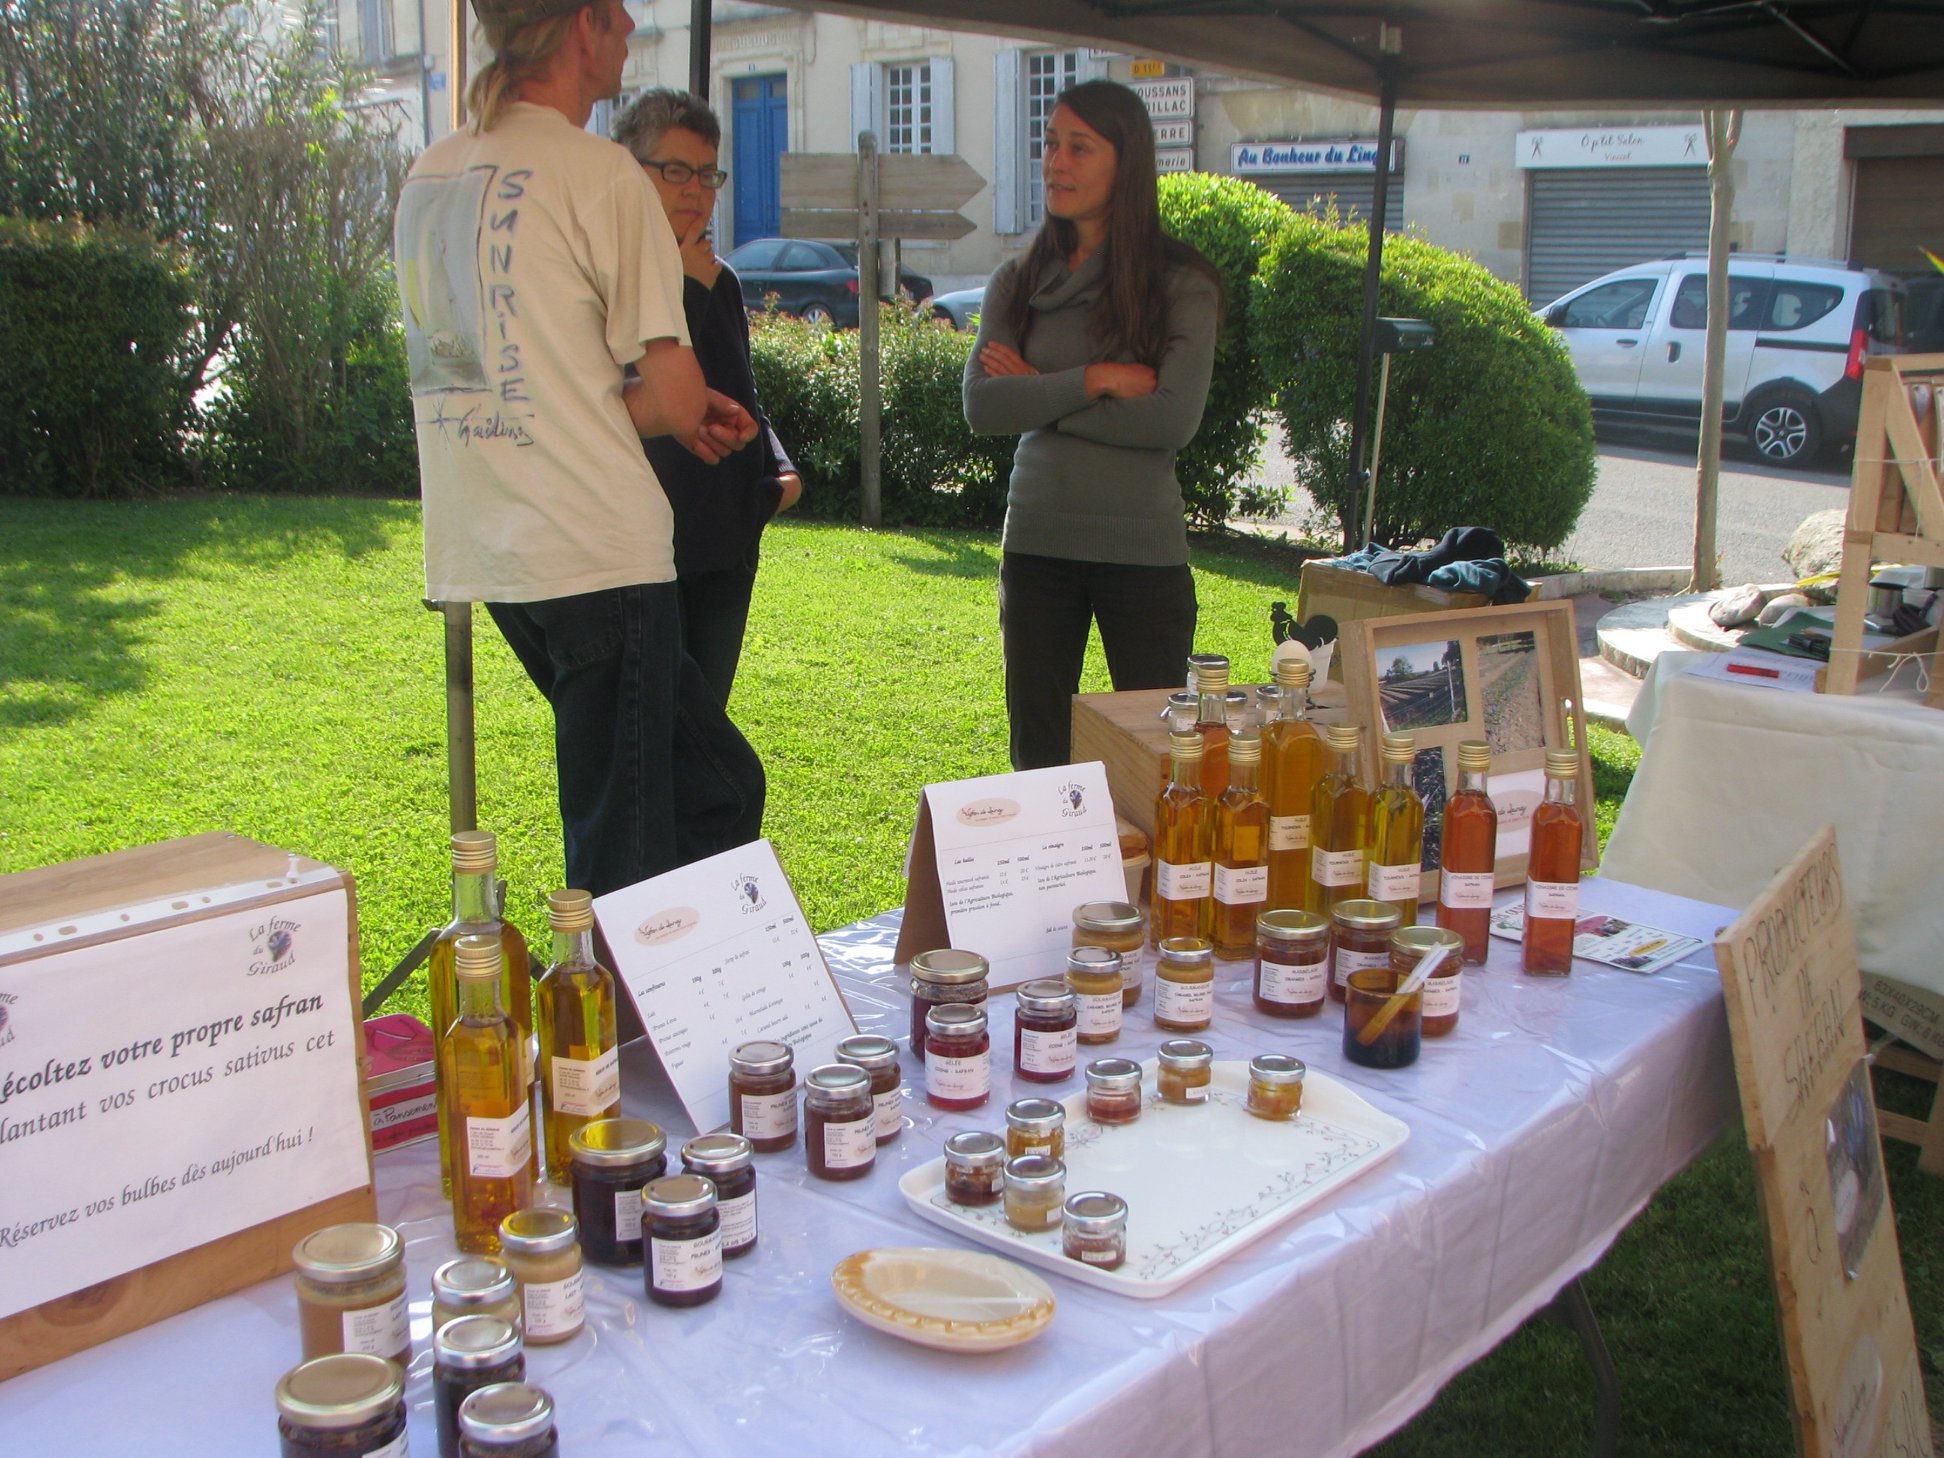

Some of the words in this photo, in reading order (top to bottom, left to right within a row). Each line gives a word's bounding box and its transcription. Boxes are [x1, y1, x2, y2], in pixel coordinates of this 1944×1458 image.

[1136, 84, 1187, 98] OUSSANS
[1238, 147, 1258, 168] Au
[1262, 146, 1322, 165] Bonheur
[1324, 145, 1344, 164] du
[1068, 780, 1086, 793] ferme
[250, 924, 265, 942] La
[268, 915, 302, 936] ferme
[252, 944, 264, 956] du
[246, 952, 296, 976] Giraud
[0, 1058, 92, 1105] écoltez
[101, 1036, 164, 1070] votre
[170, 1015, 244, 1058] propre
[250, 994, 324, 1029] safran
[0, 1101, 88, 1145] lantant
[100, 1089, 136, 1114] vos
[148, 1066, 214, 1100] crocus
[224, 1041, 296, 1078] sativus
[306, 1030, 336, 1052] cet
[0, 1208, 80, 1248] Réservez
[85, 1196, 116, 1218] vos
[121, 1176, 178, 1206] bulbes
[182, 1163, 207, 1187] dès
[211, 1130, 303, 1175] aujourd'hui
